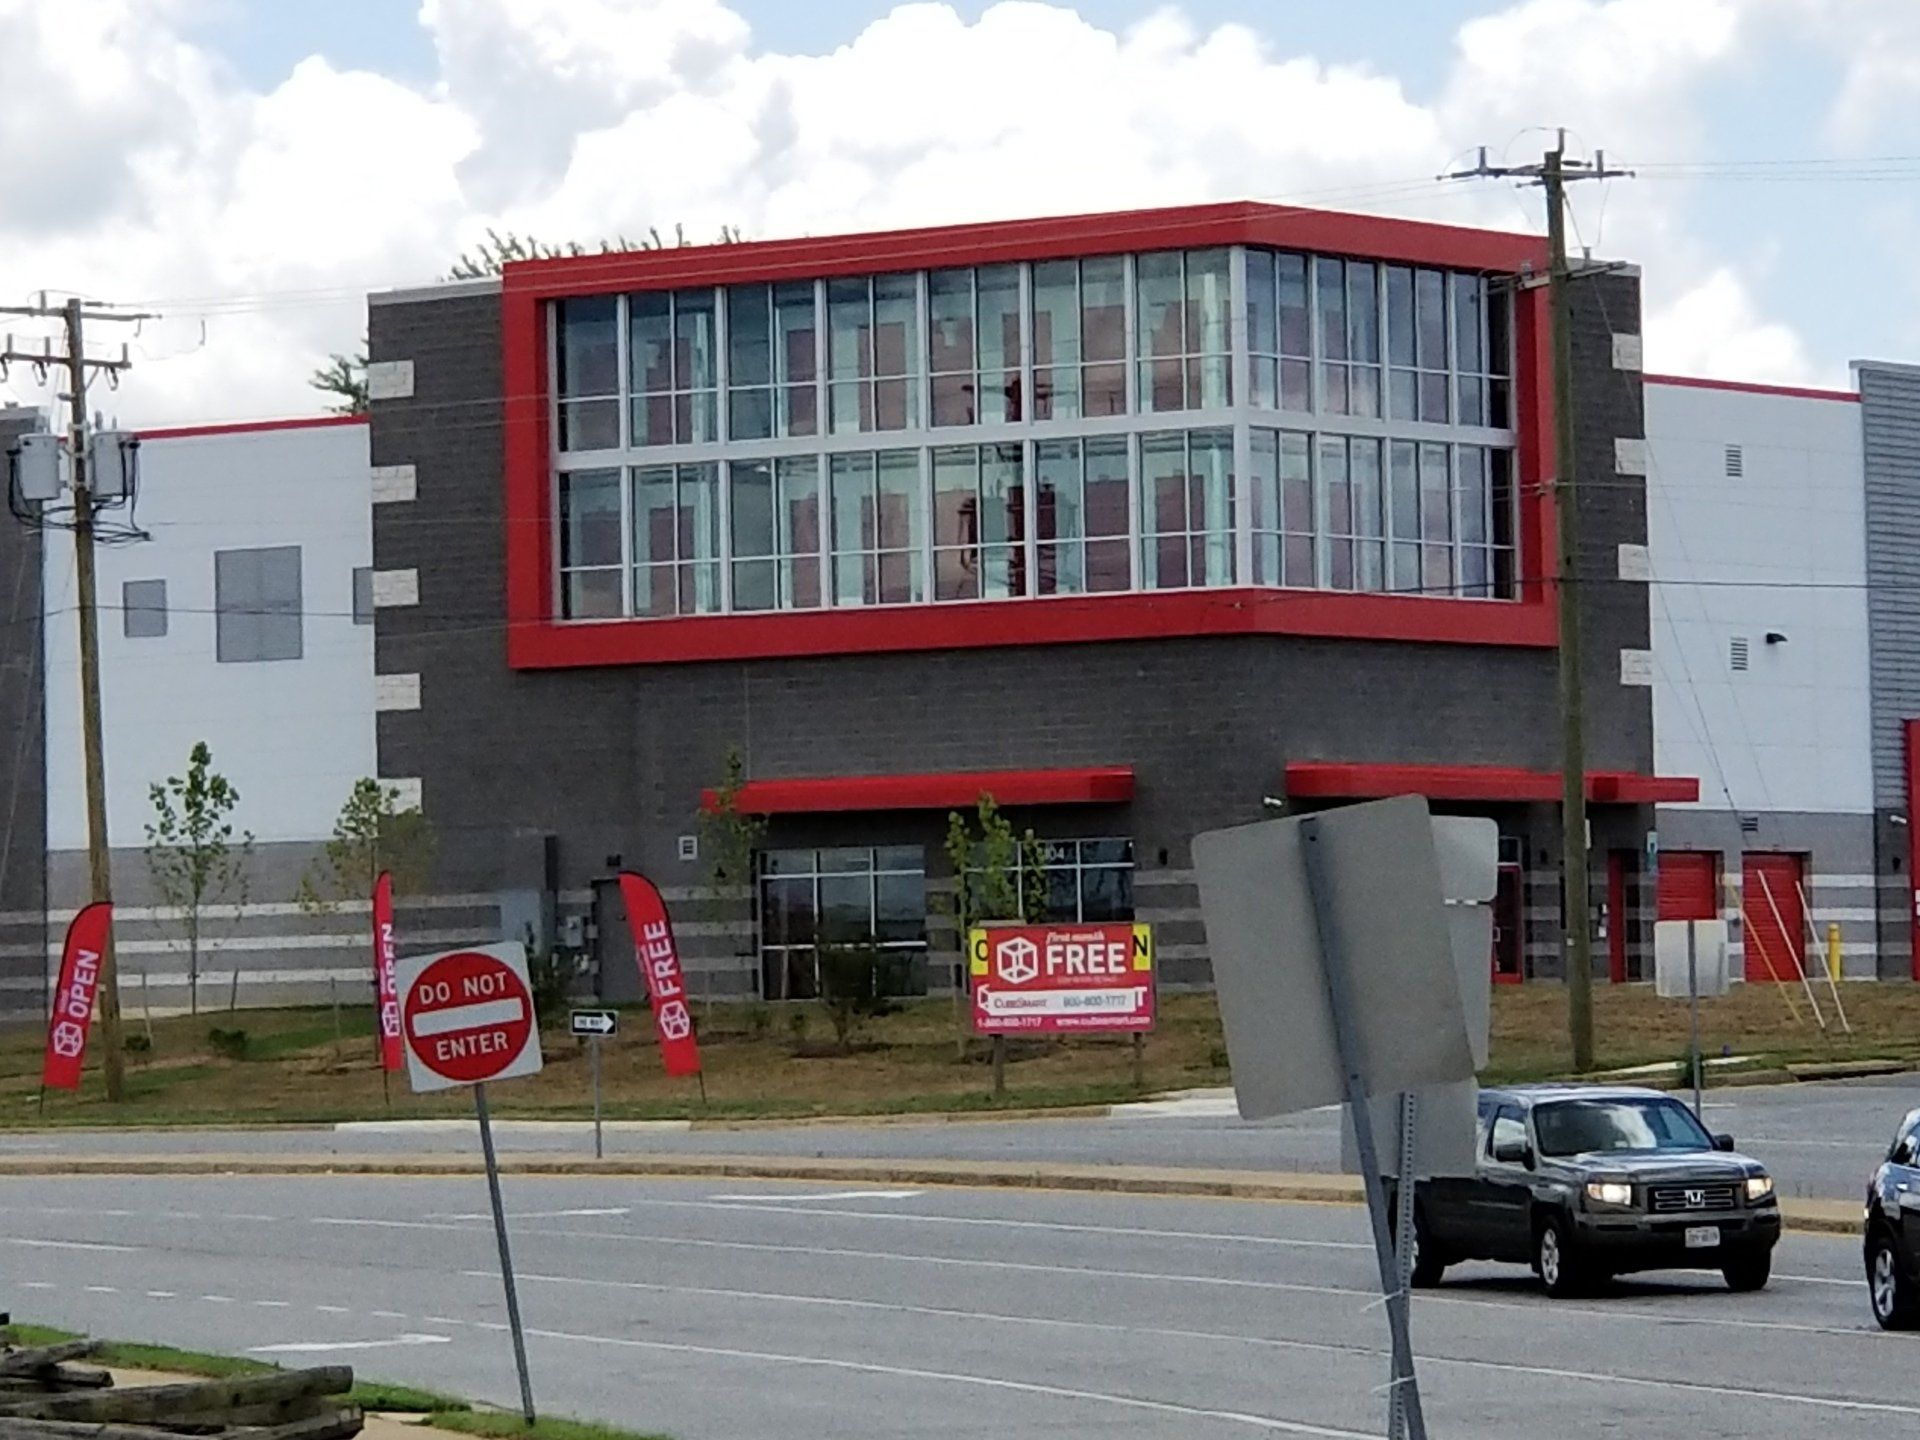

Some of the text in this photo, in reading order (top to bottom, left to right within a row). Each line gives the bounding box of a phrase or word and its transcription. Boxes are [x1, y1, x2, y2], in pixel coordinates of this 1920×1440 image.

[643, 920, 681, 996] FREE
[1046, 942, 1126, 975] FREE
[68, 949, 99, 1018] OPEN
[419, 971, 507, 1005] DO NOT
[436, 1032, 509, 1062] ENTER
